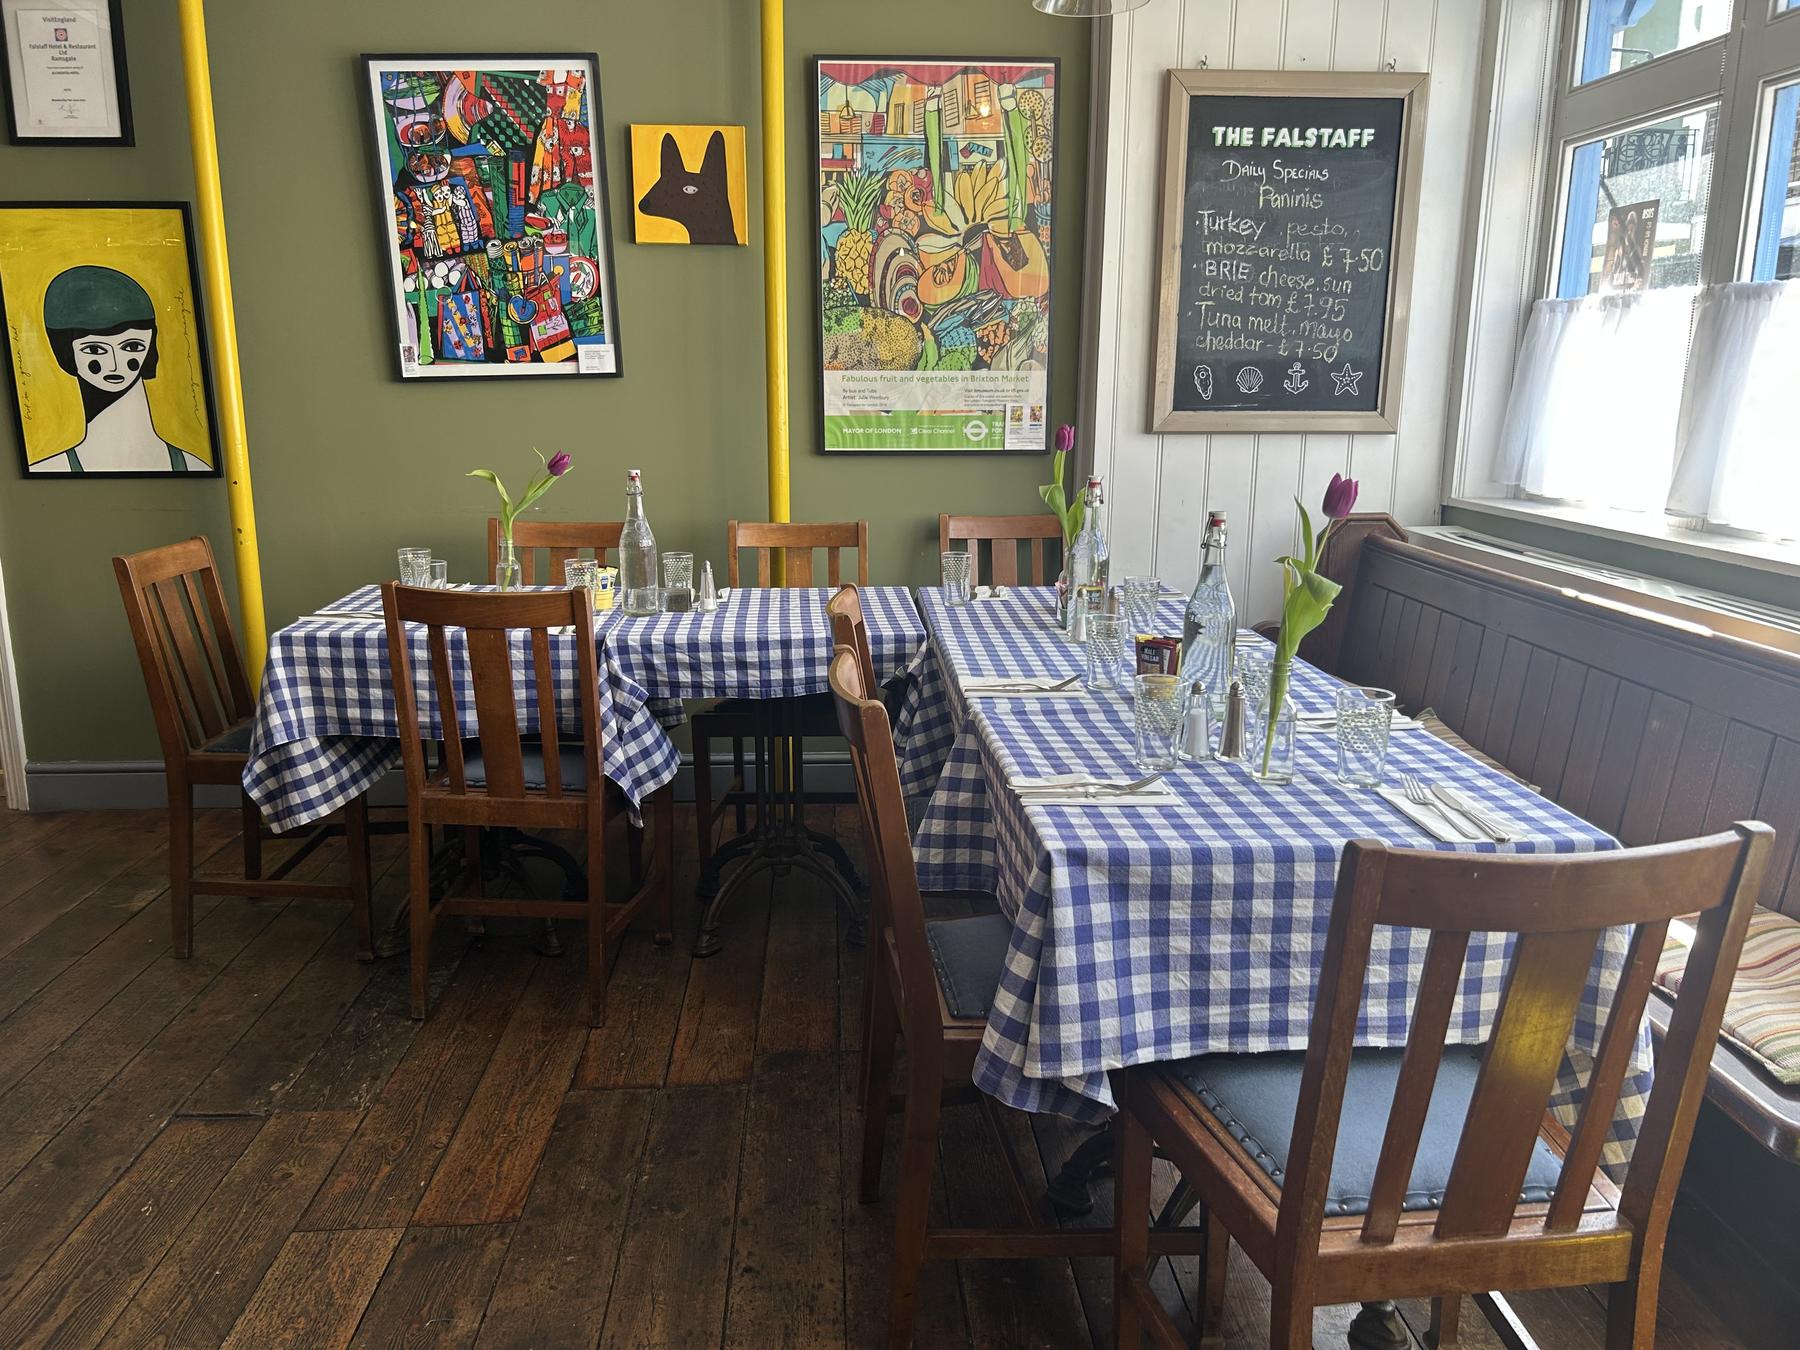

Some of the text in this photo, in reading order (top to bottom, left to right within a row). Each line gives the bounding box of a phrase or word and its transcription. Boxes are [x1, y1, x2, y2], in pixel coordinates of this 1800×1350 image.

[1211, 126, 1376, 148] THE FALSTAFF
[1259, 185, 1323, 209] Paninis
[1197, 210, 1266, 240] Turkey
[1205, 240, 1311, 263] mozzarella
[1205, 260, 1252, 282] BRIE
[1323, 277, 1352, 295] sun
[1198, 281, 1244, 304] dried
[1249, 286, 1282, 309] tom
[1195, 301, 1242, 330] Tuna
[1299, 320, 1353, 345] mayo
[1195, 330, 1264, 351] cheddar
[841, 374, 878, 383] Fabulous
[880, 374, 897, 383] fruit
[900, 374, 914, 383] and
[916, 374, 959, 384] vegetables
[970, 375, 1000, 383] Brixton
[1001, 375, 1029, 383] Market
